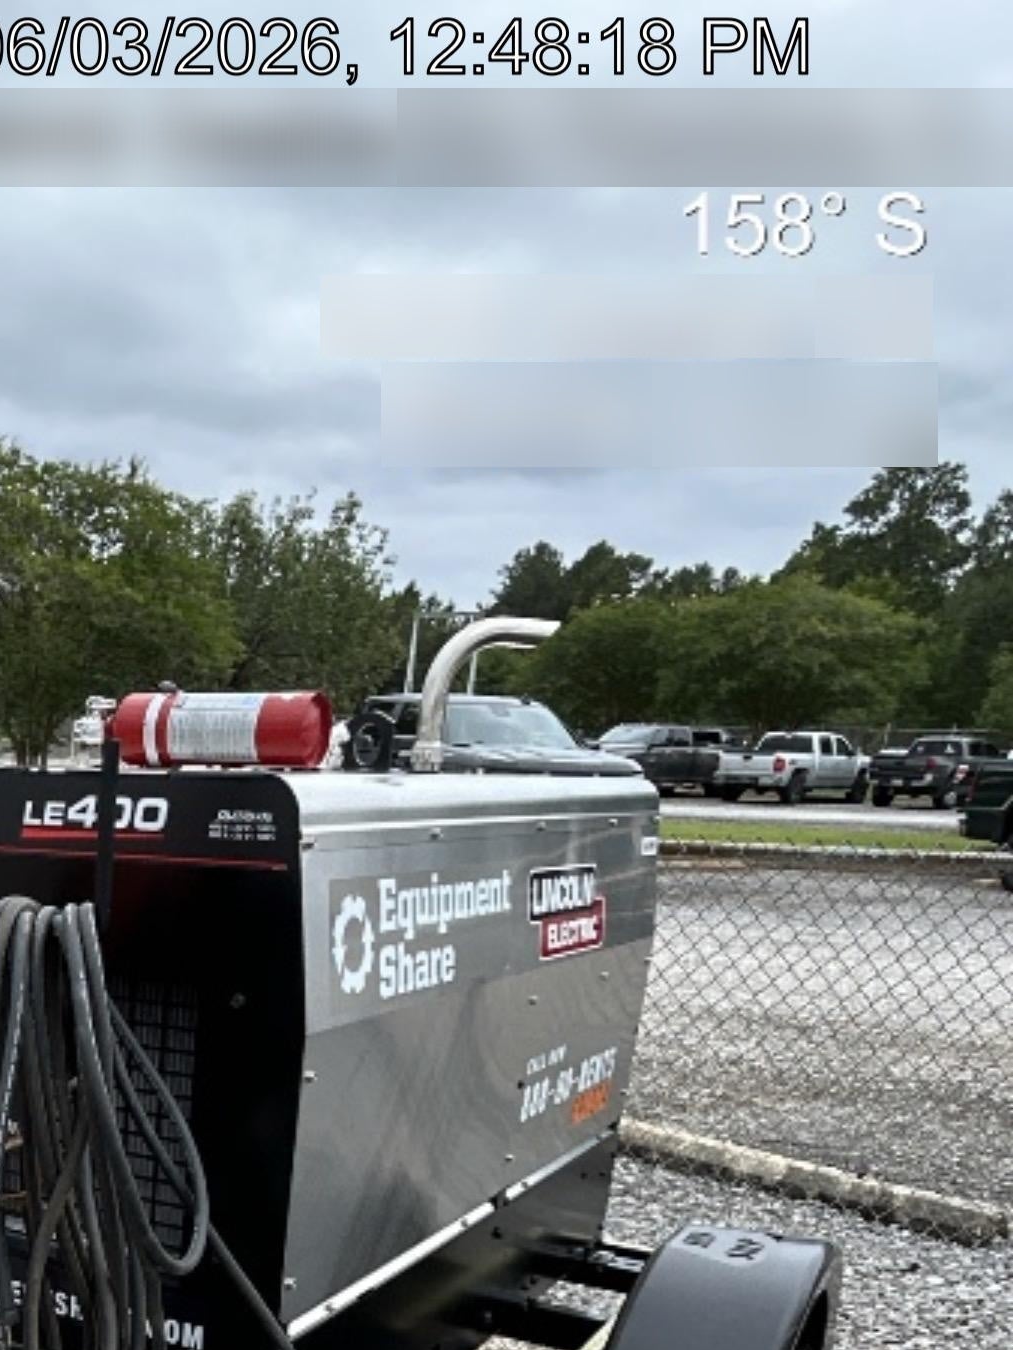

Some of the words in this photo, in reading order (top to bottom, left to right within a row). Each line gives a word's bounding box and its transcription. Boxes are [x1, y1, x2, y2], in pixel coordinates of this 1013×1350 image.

[378, 869, 512, 940] Equipment
[532, 873, 594, 915] LINCOLN
[547, 915, 599, 950] ELECTRIC
[379, 941, 456, 999] Share
